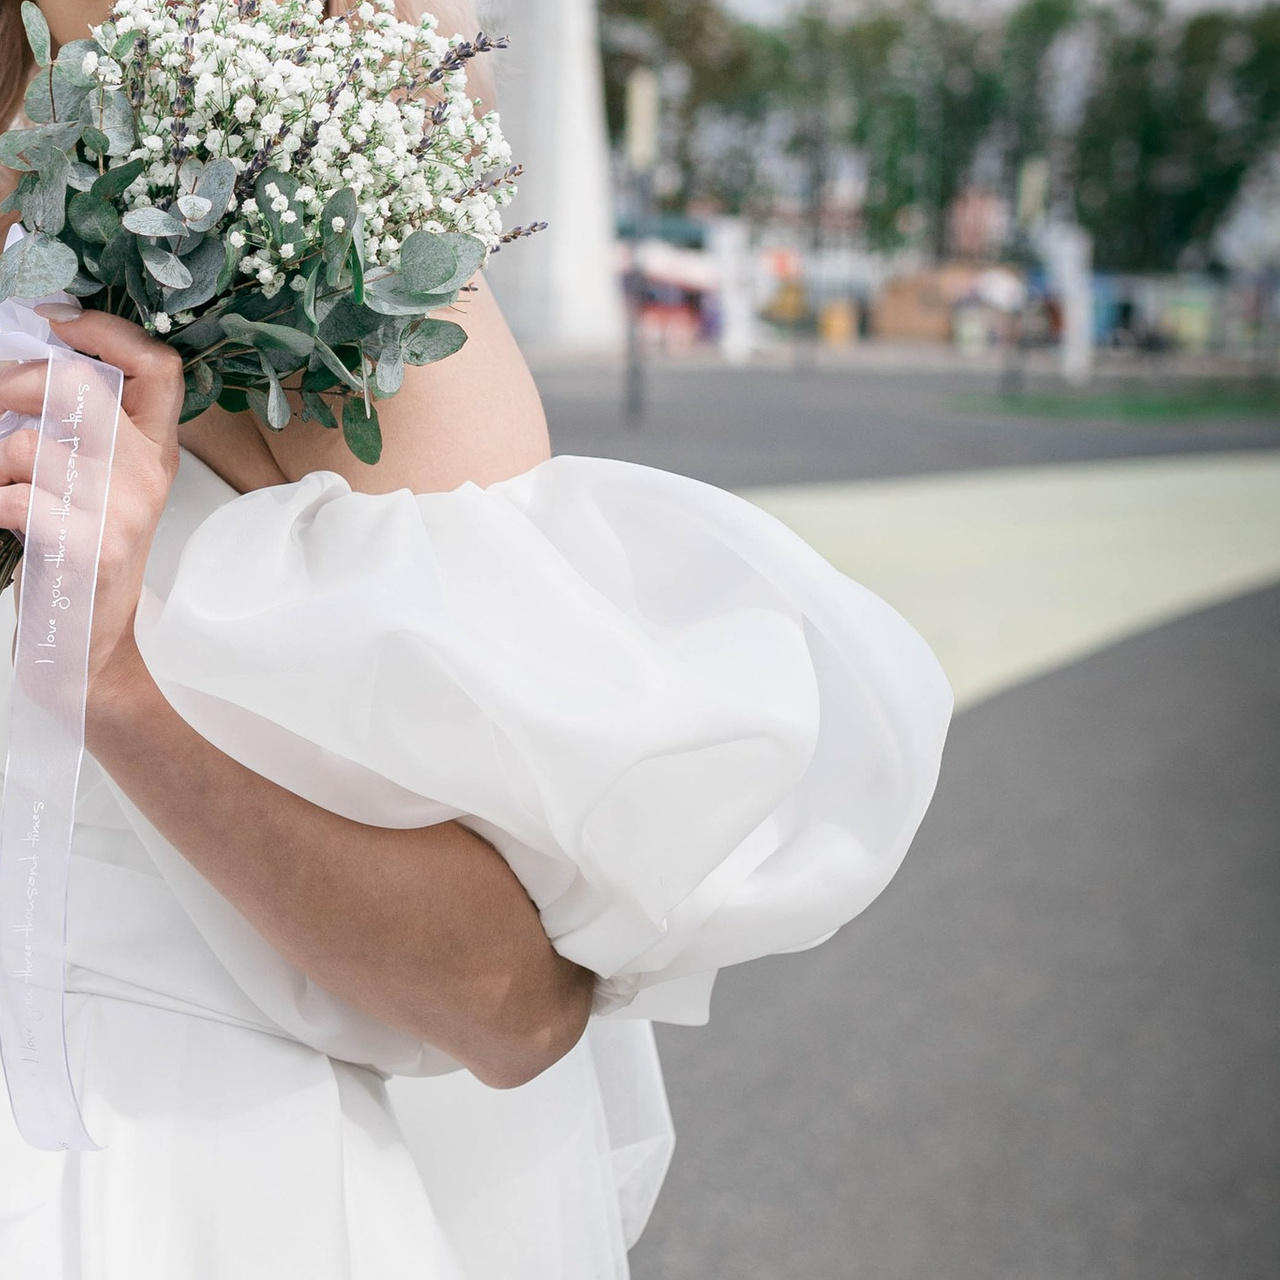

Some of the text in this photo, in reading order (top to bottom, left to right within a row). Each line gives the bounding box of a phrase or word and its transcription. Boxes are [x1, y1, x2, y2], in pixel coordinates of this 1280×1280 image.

[60, 382, 90, 430] times
[49, 435, 81, 521] thousand
[43, 527, 67, 569] three
[50, 574, 71, 610] you
[36, 618, 57, 648] love
[20, 800, 45, 847] times
[12, 854, 40, 938] thousand
[11, 944, 33, 984] three
[20, 1027, 39, 1051] love
